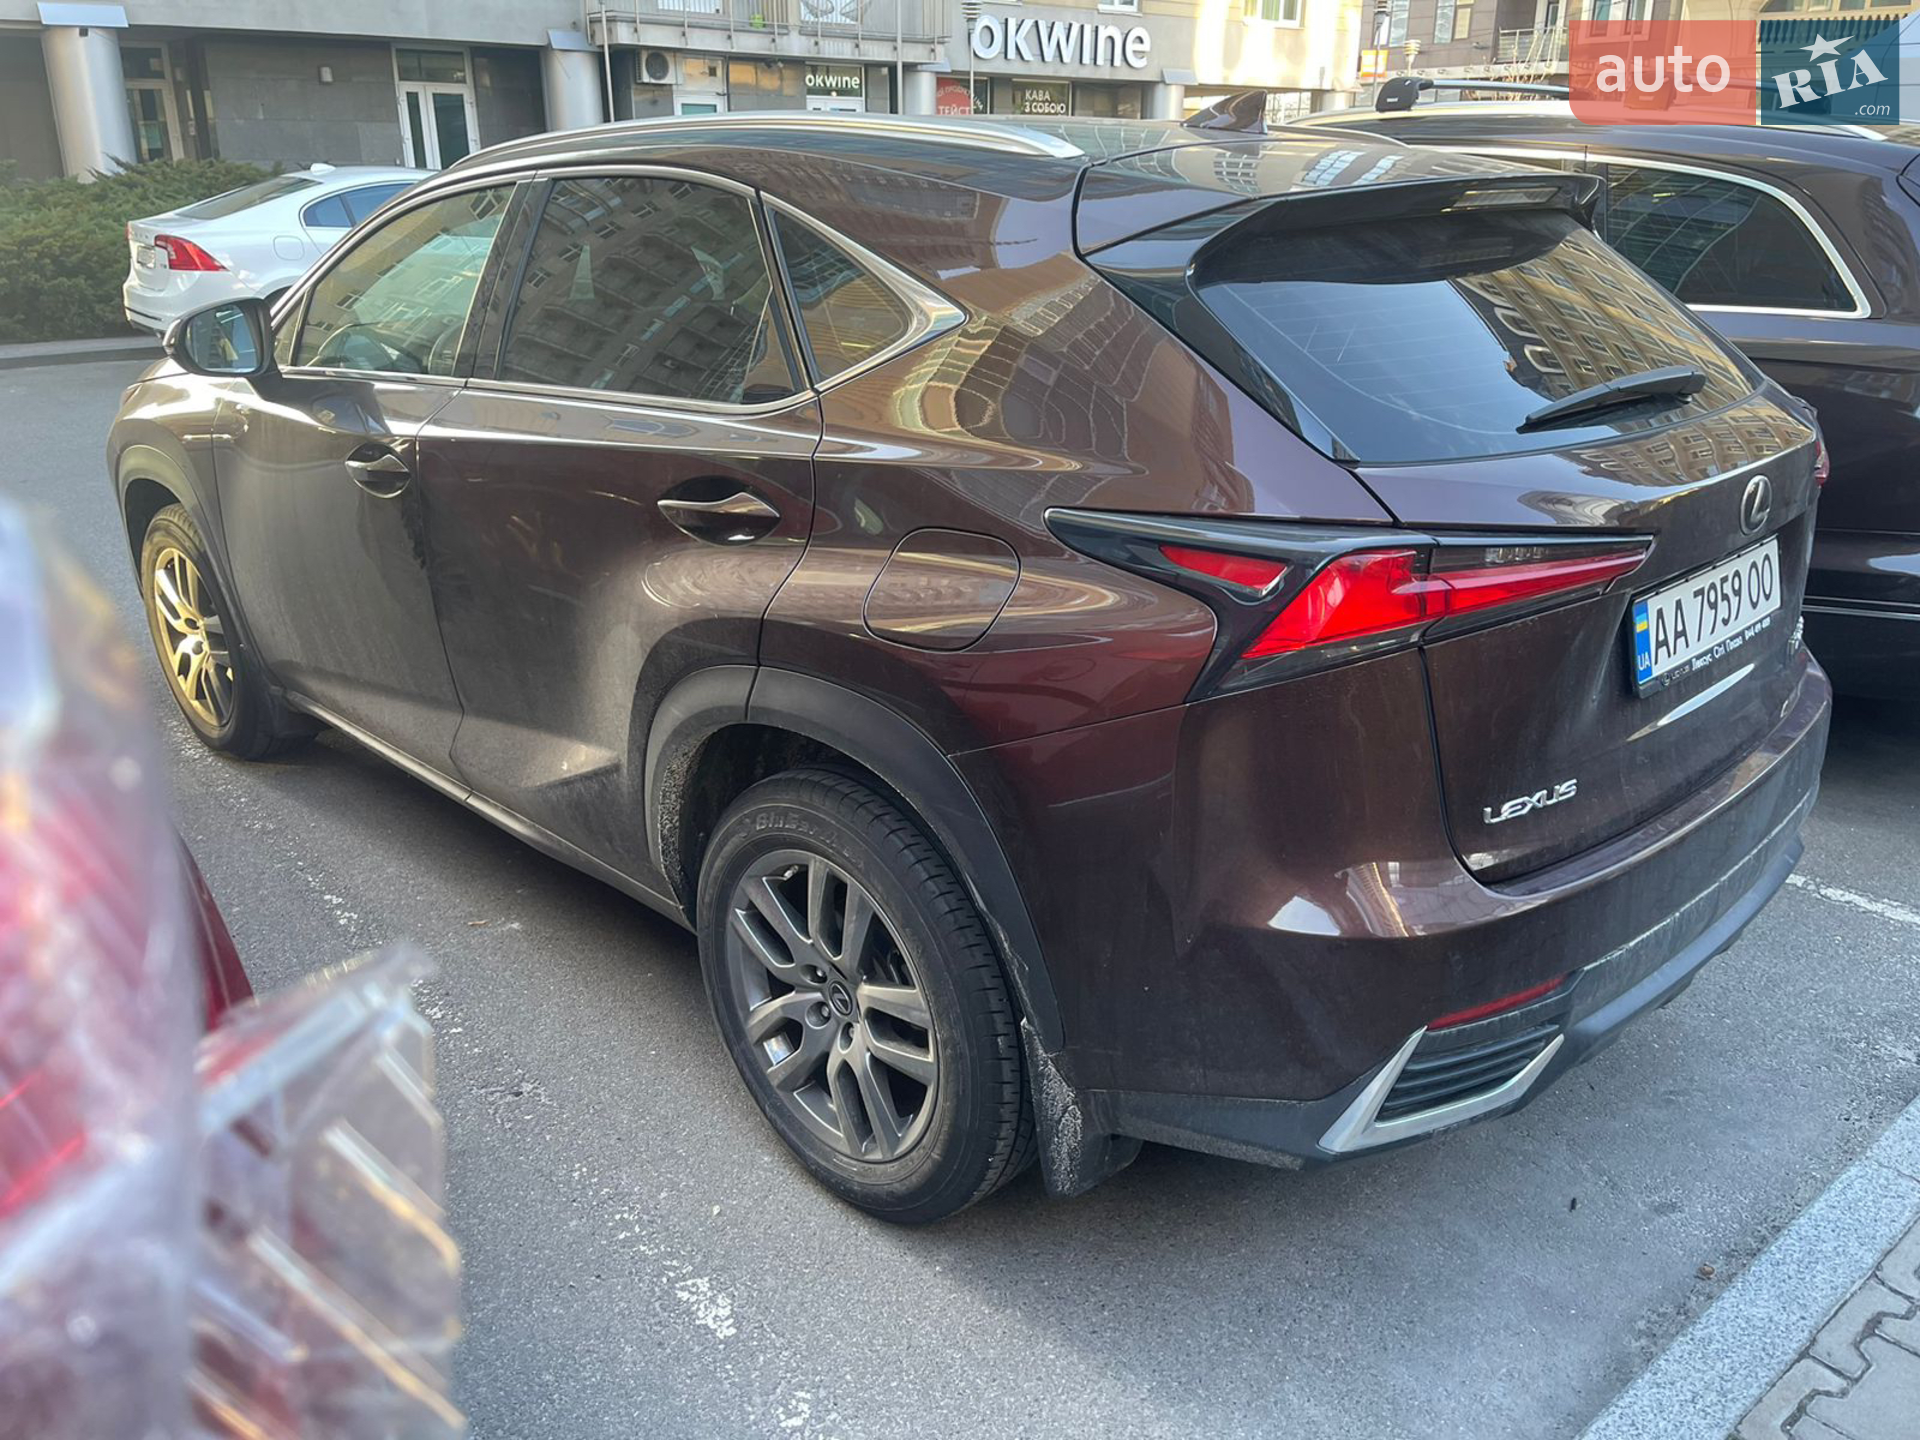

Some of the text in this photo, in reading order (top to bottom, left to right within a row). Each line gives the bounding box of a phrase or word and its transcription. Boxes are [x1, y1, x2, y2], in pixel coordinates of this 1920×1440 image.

[1025, 90, 1051, 101] КАВА
[1031, 103, 1066, 114] СОБОЮ
[1654, 597, 1690, 666] AA
[1693, 568, 1742, 643] 7959
[1638, 651, 1651, 671] UA
[1482, 778, 1578, 824] LEXUS
